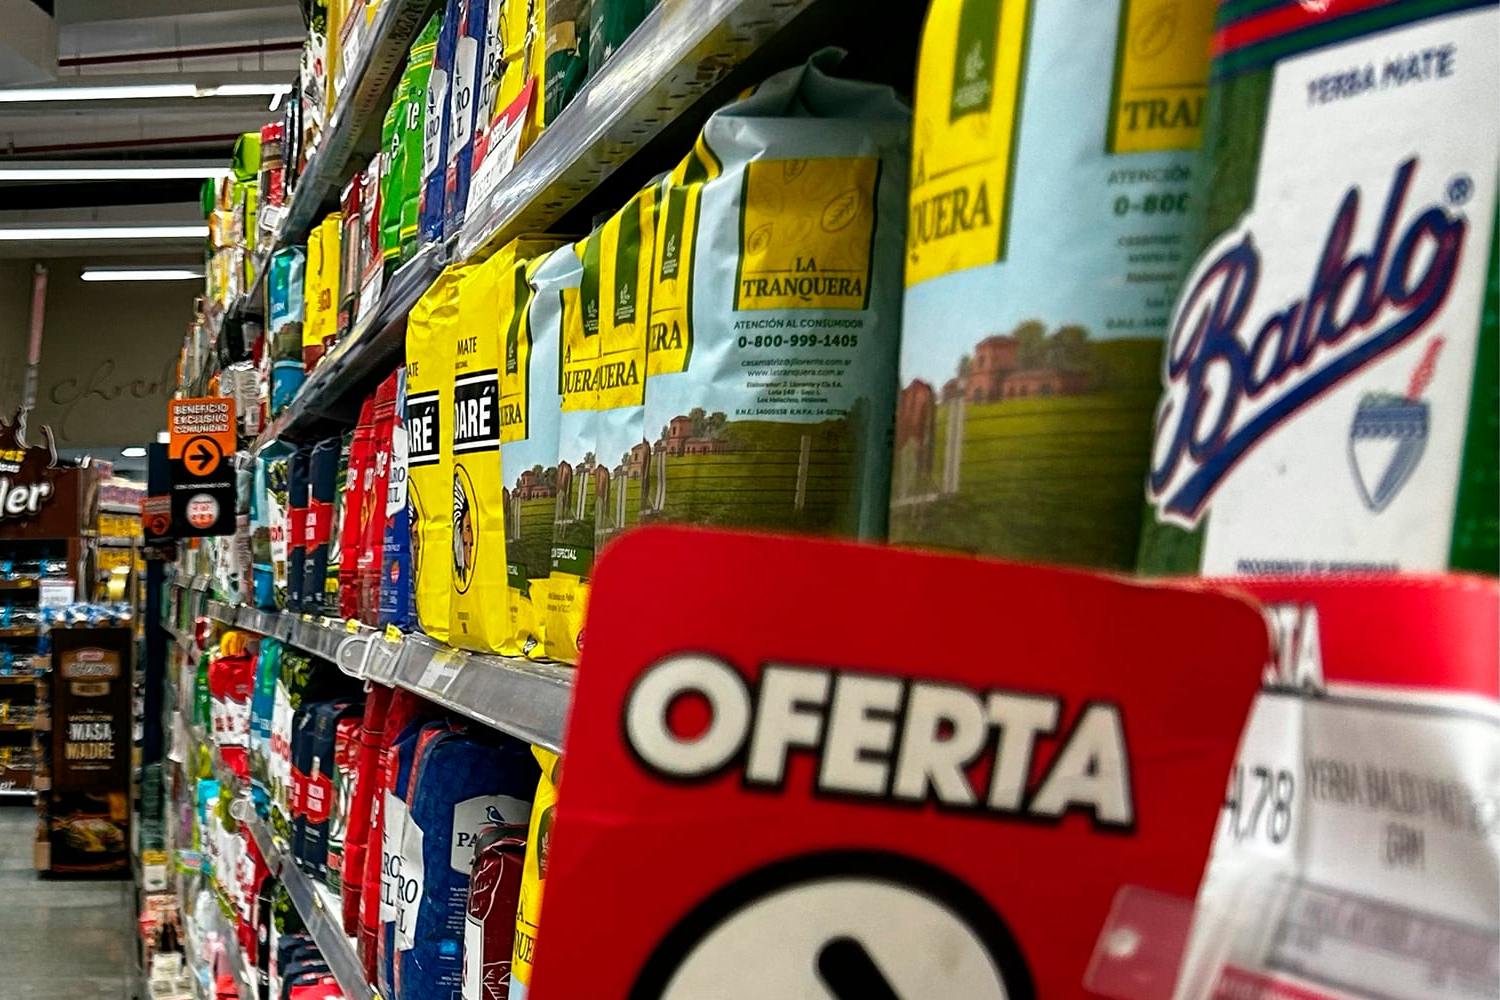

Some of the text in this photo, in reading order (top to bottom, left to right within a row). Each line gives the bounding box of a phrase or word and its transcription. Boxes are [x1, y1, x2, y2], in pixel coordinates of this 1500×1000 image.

[1306, 43, 1458, 107] YERBA MATE
[796, 257, 817, 272] LA
[743, 276, 863, 301] TRANQUERA
[734, 318, 864, 330] ATENCIÓN AL CONSUMIDOR
[738, 334, 858, 348] 0-800-999-1405
[1149, 155, 1470, 515] Baldo
[457, 337, 477, 355] MATE
[406, 362, 419, 377] ATE
[174, 403, 229, 414] BENEFICIO
[174, 414, 229, 424] EXCLUSIVO
[174, 424, 229, 434] COMUNIDAD
[70, 722, 113, 740] MASA
[625, 651, 1136, 832] OFERTA
[65, 742, 115, 759] MADRE
